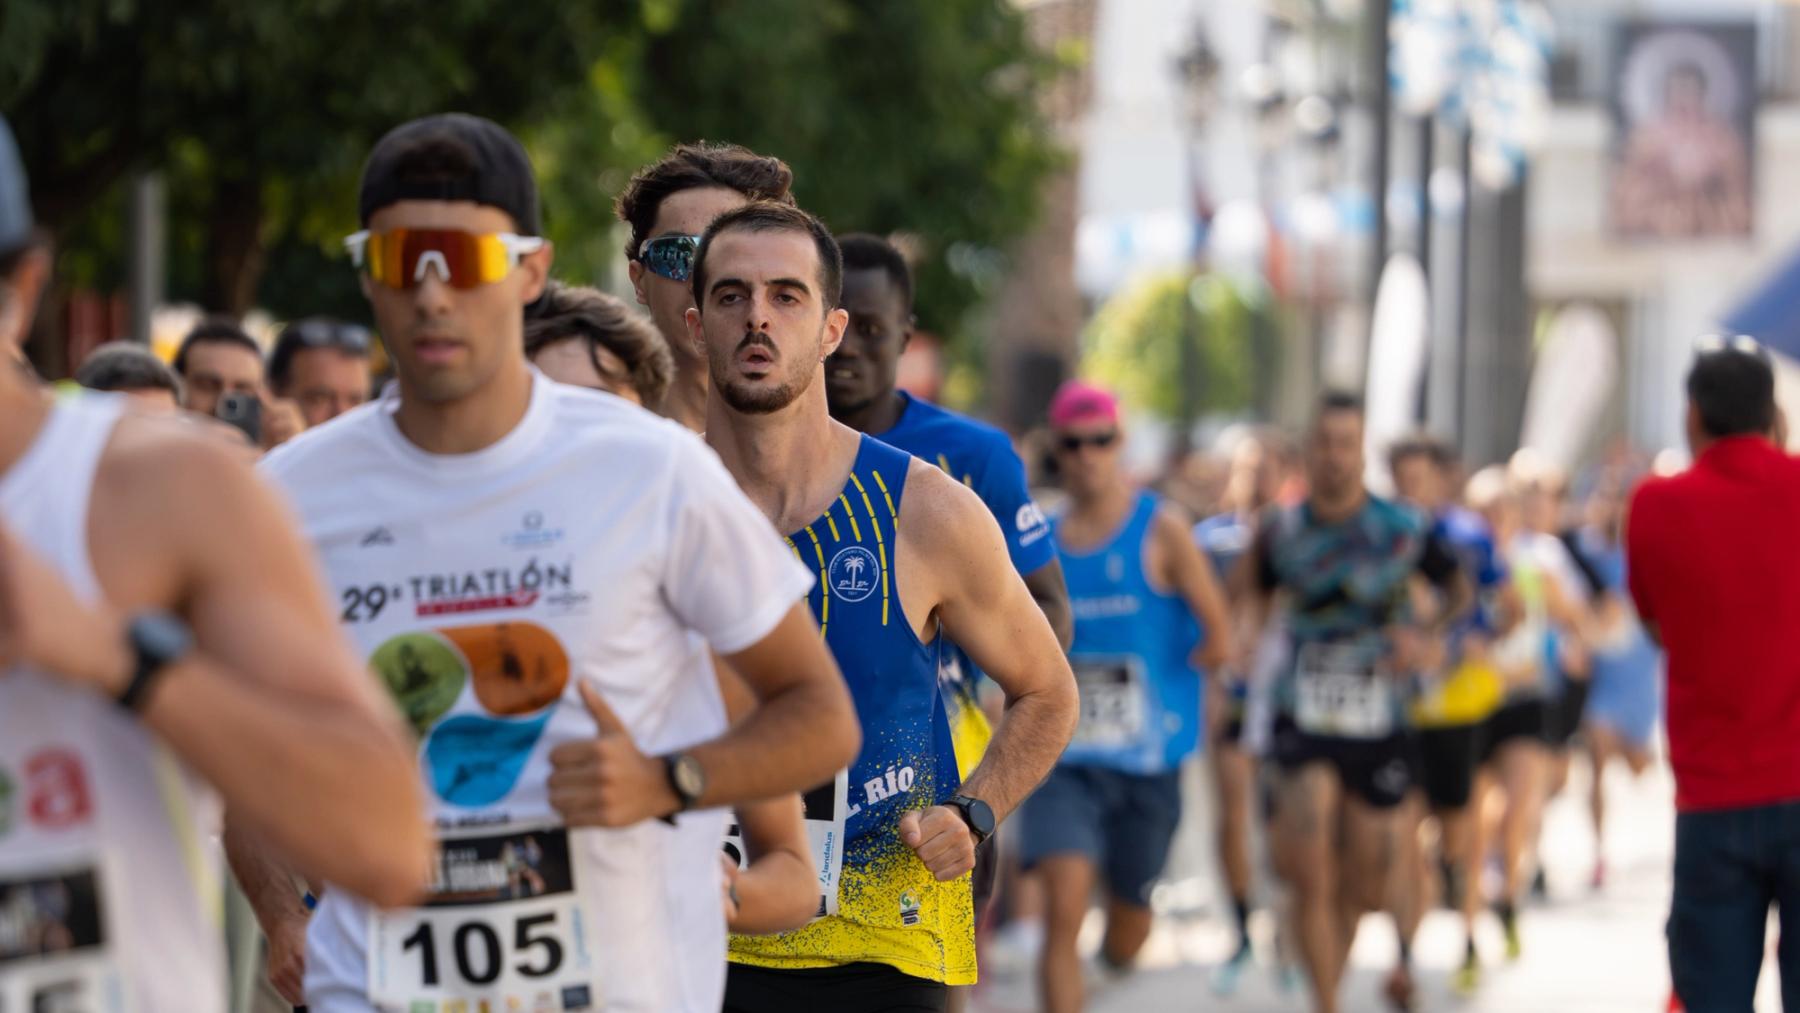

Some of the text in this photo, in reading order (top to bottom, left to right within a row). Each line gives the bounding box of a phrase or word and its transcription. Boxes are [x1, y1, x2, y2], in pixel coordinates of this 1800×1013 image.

[409, 556, 572, 600] TRIATLÓN
[864, 765, 914, 806] RÍO
[403, 913, 564, 987] 105
